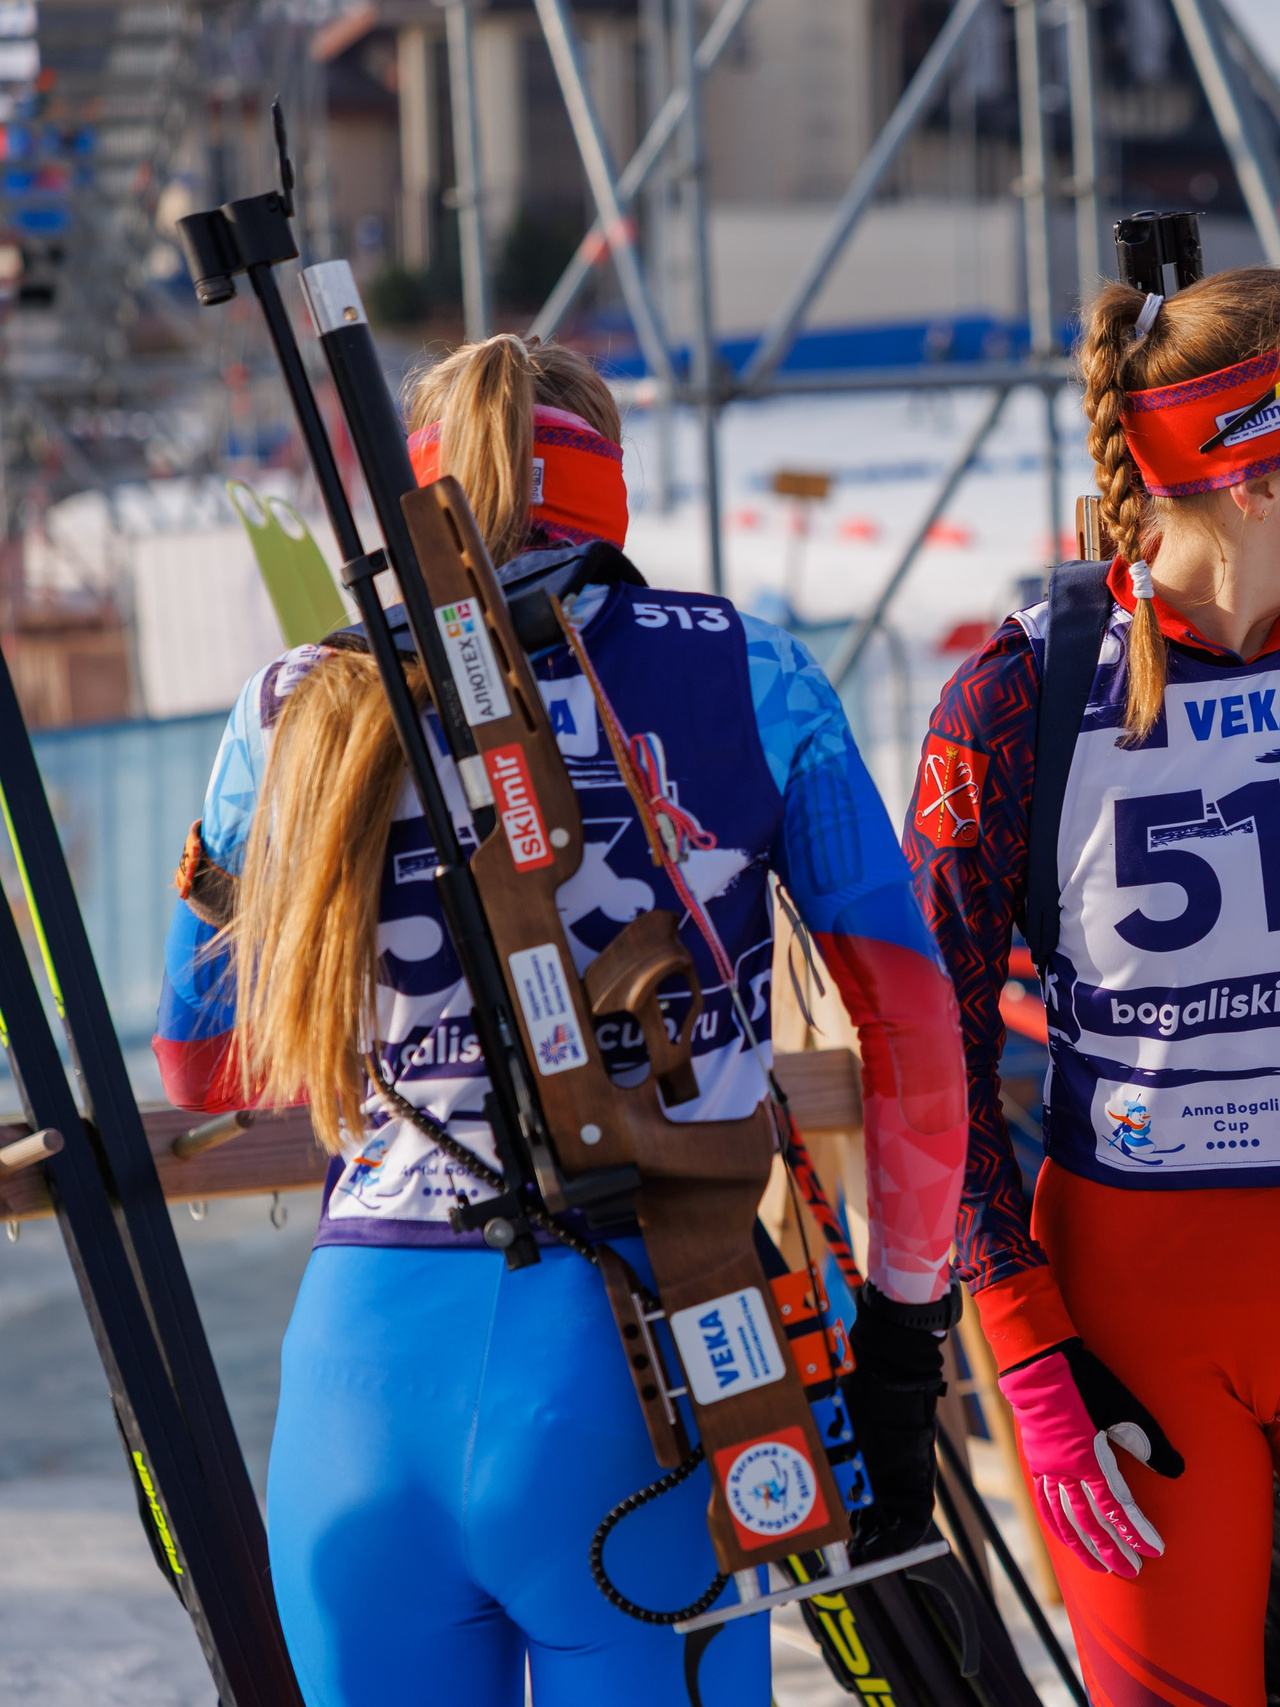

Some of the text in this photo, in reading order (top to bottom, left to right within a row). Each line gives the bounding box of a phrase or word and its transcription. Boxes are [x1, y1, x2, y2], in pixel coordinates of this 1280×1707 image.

[633, 603, 731, 632] 513
[457, 638, 496, 717] АЛЮТЕХ
[493, 755, 548, 857] skimir
[1181, 1098, 1280, 1118] Anna Bogali
[1213, 1118, 1249, 1135] Cup
[698, 1308, 740, 1389] VEKA
